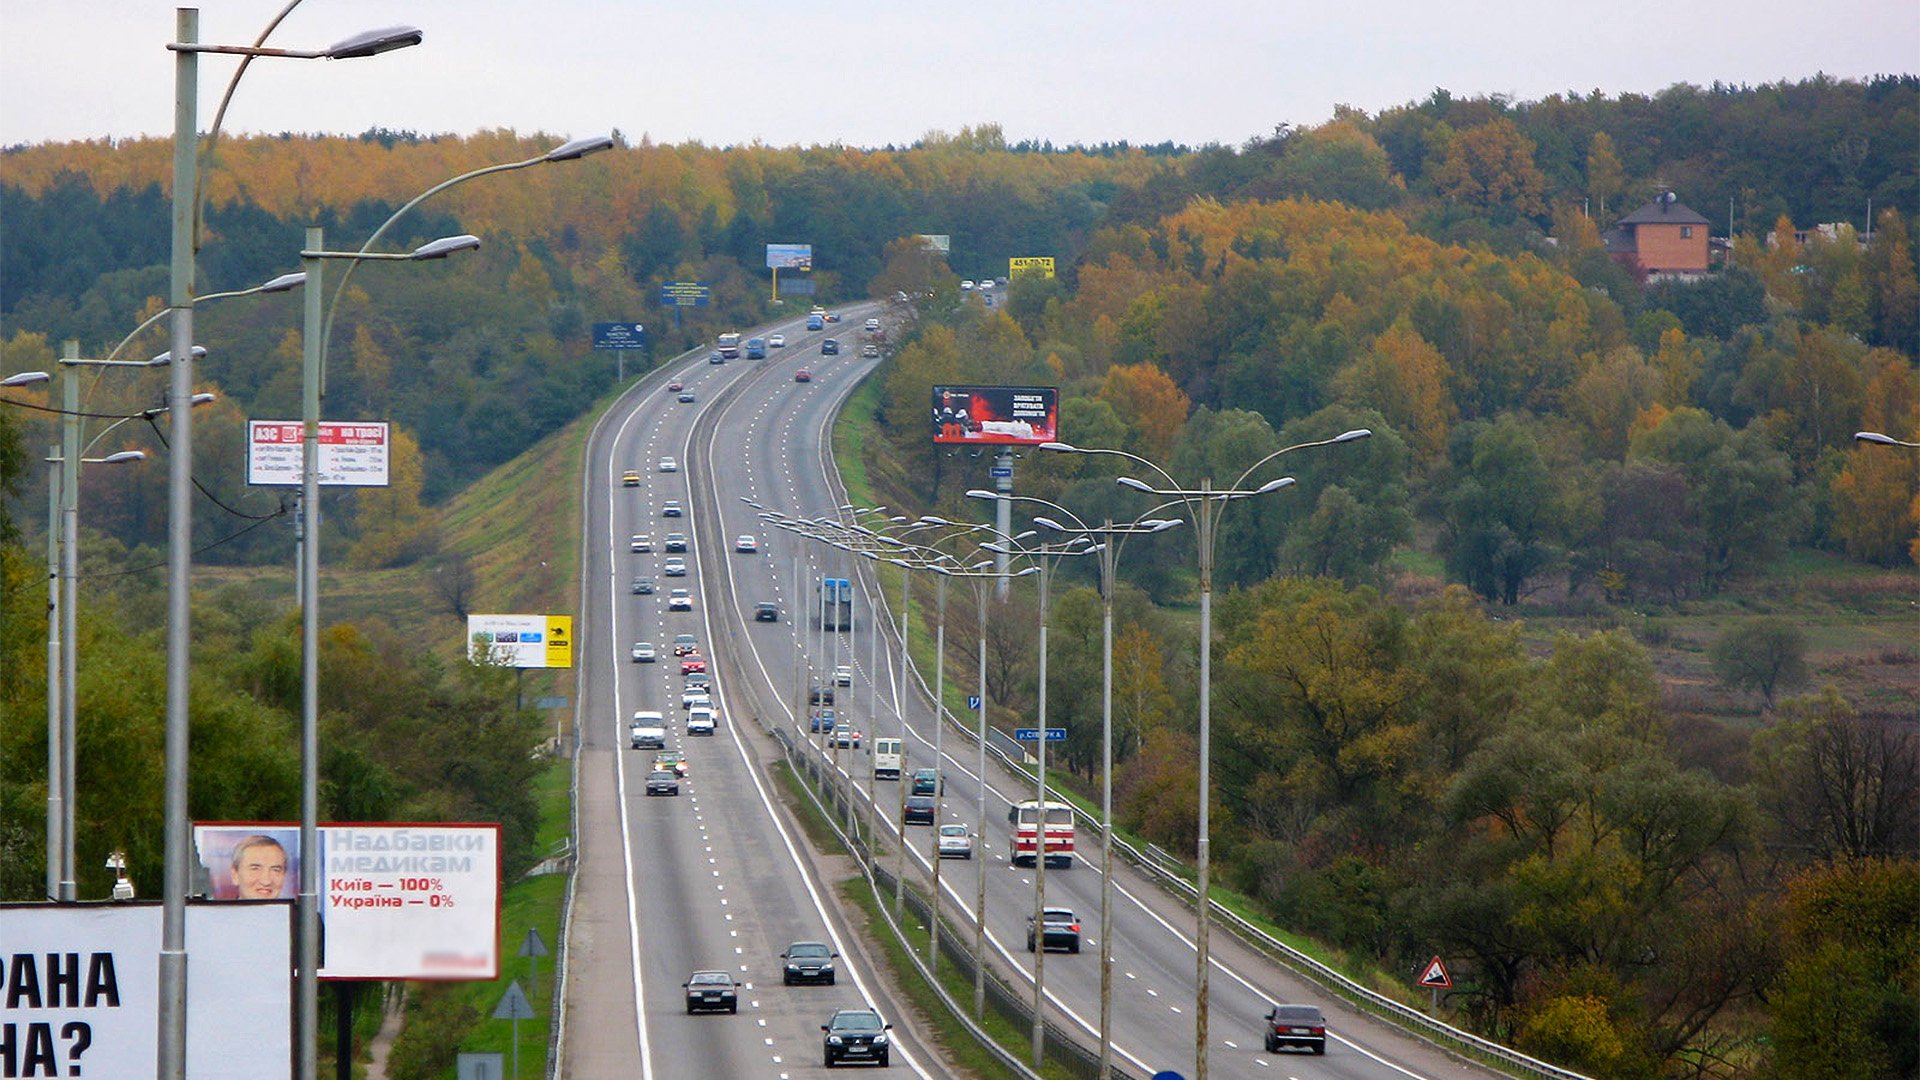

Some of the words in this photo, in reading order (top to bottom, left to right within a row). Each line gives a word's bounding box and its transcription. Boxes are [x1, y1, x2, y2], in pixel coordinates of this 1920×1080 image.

[255, 427, 278, 440] АЗС
[332, 830, 484, 852] Надбавки
[332, 855, 471, 874] медикам
[331, 877, 373, 892] Київ
[400, 878, 443, 892] 100%
[331, 893, 403, 911] Україна
[429, 894, 454, 908] 0%
[0, 952, 121, 1009] АНА
